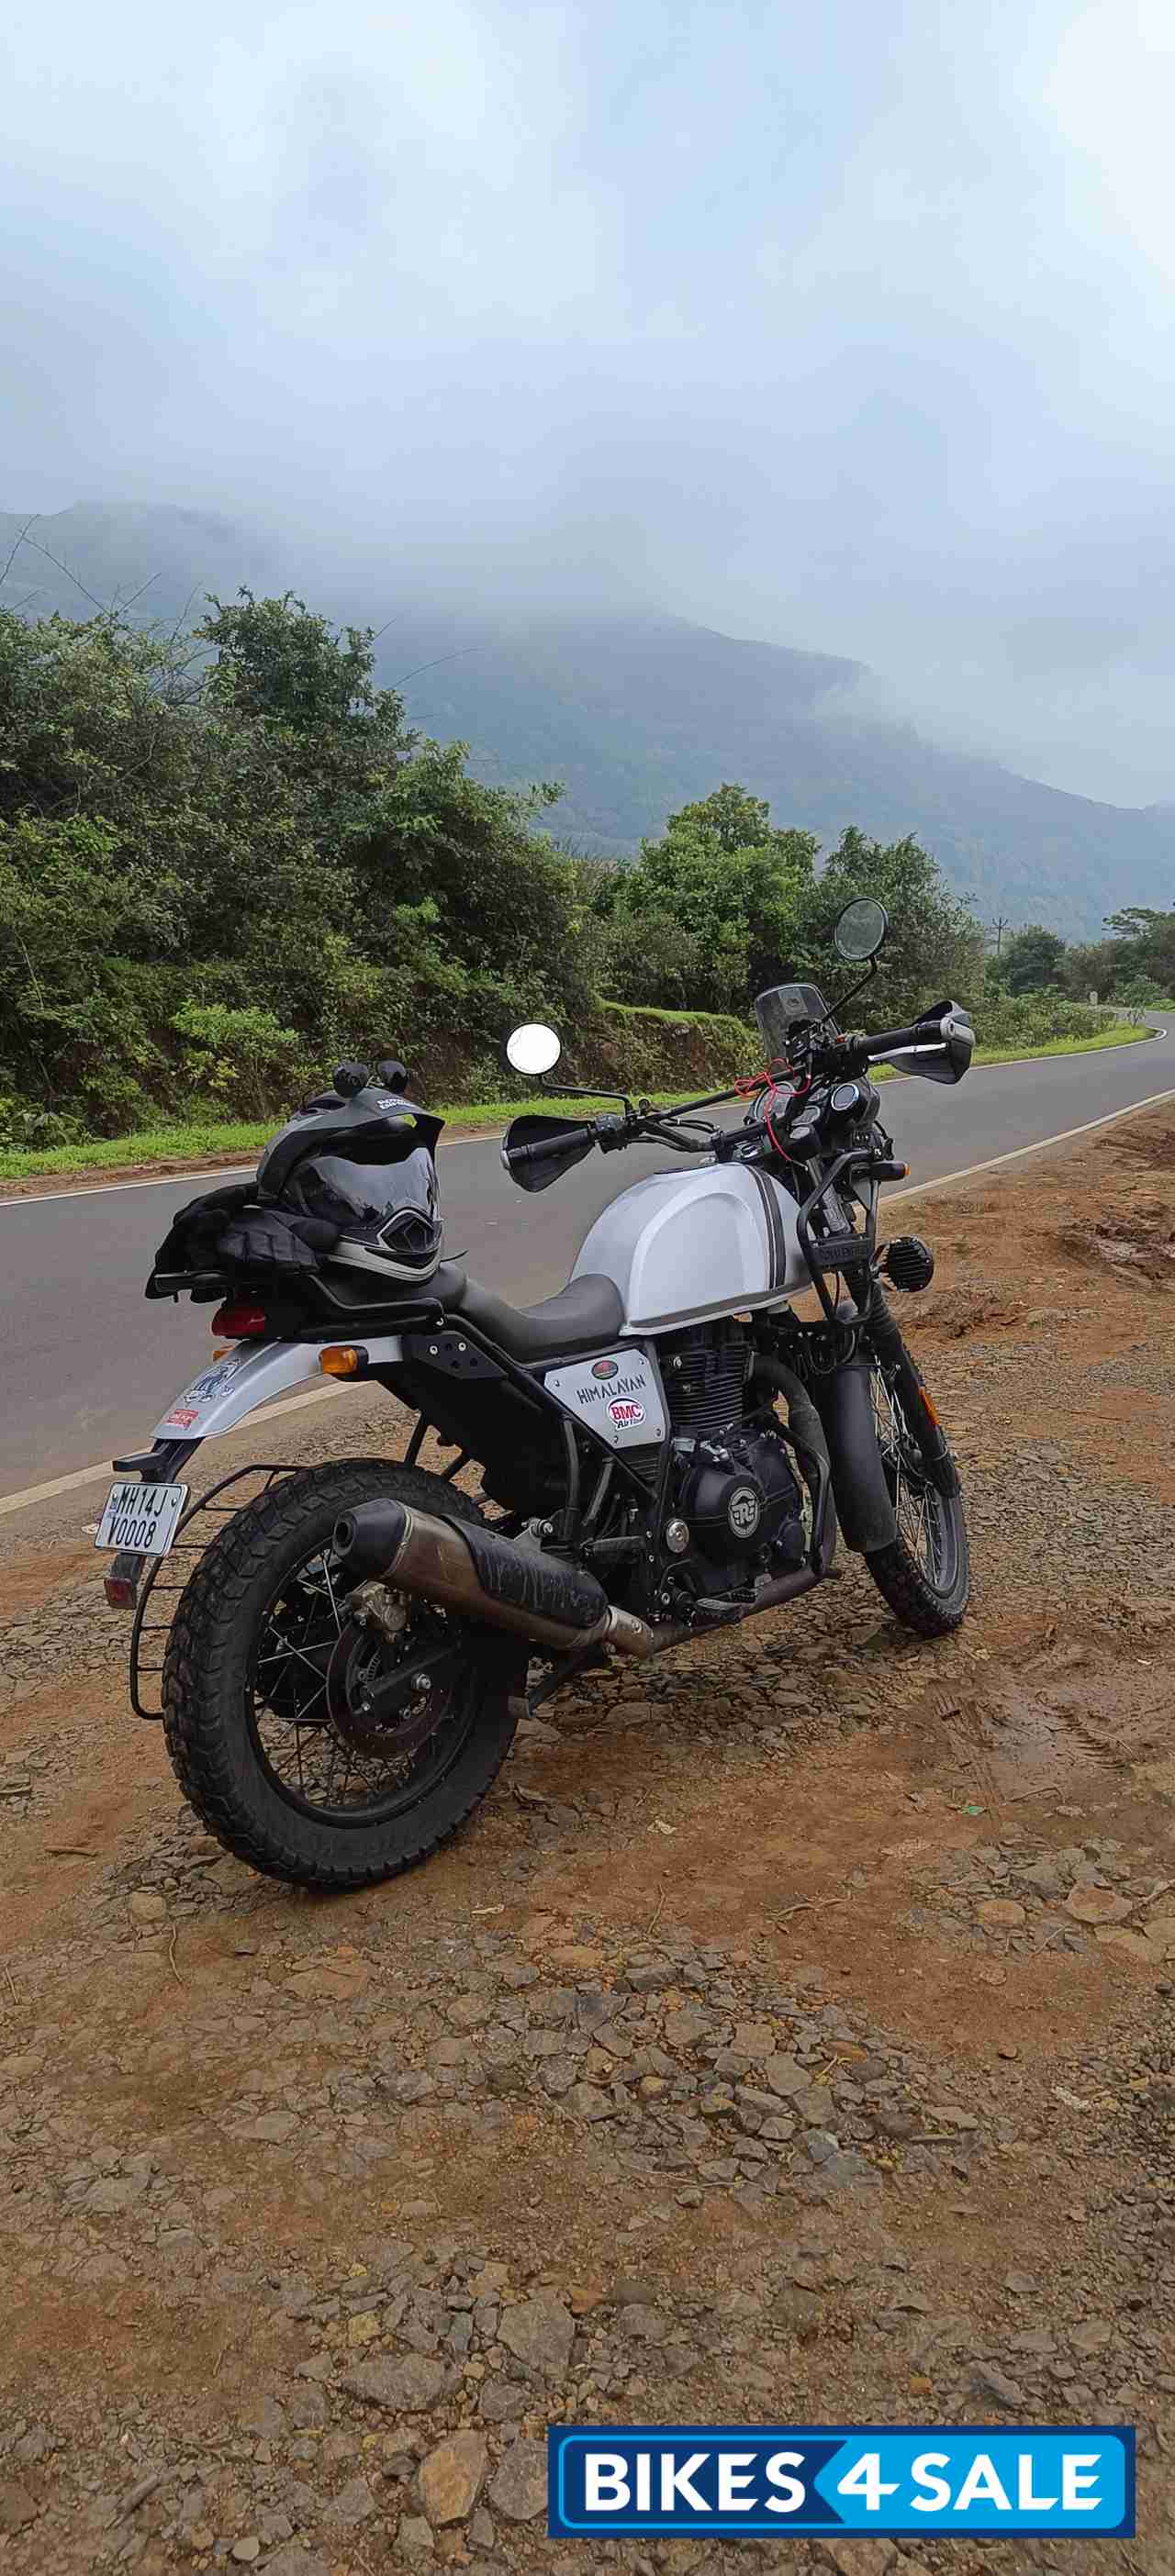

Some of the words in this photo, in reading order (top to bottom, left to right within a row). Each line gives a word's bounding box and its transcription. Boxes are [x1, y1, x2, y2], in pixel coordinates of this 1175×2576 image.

[576, 1374, 647, 1405] HIMALAYAN
[610, 1405, 642, 1421] BMC
[107, 1516, 157, 1548] V0008
